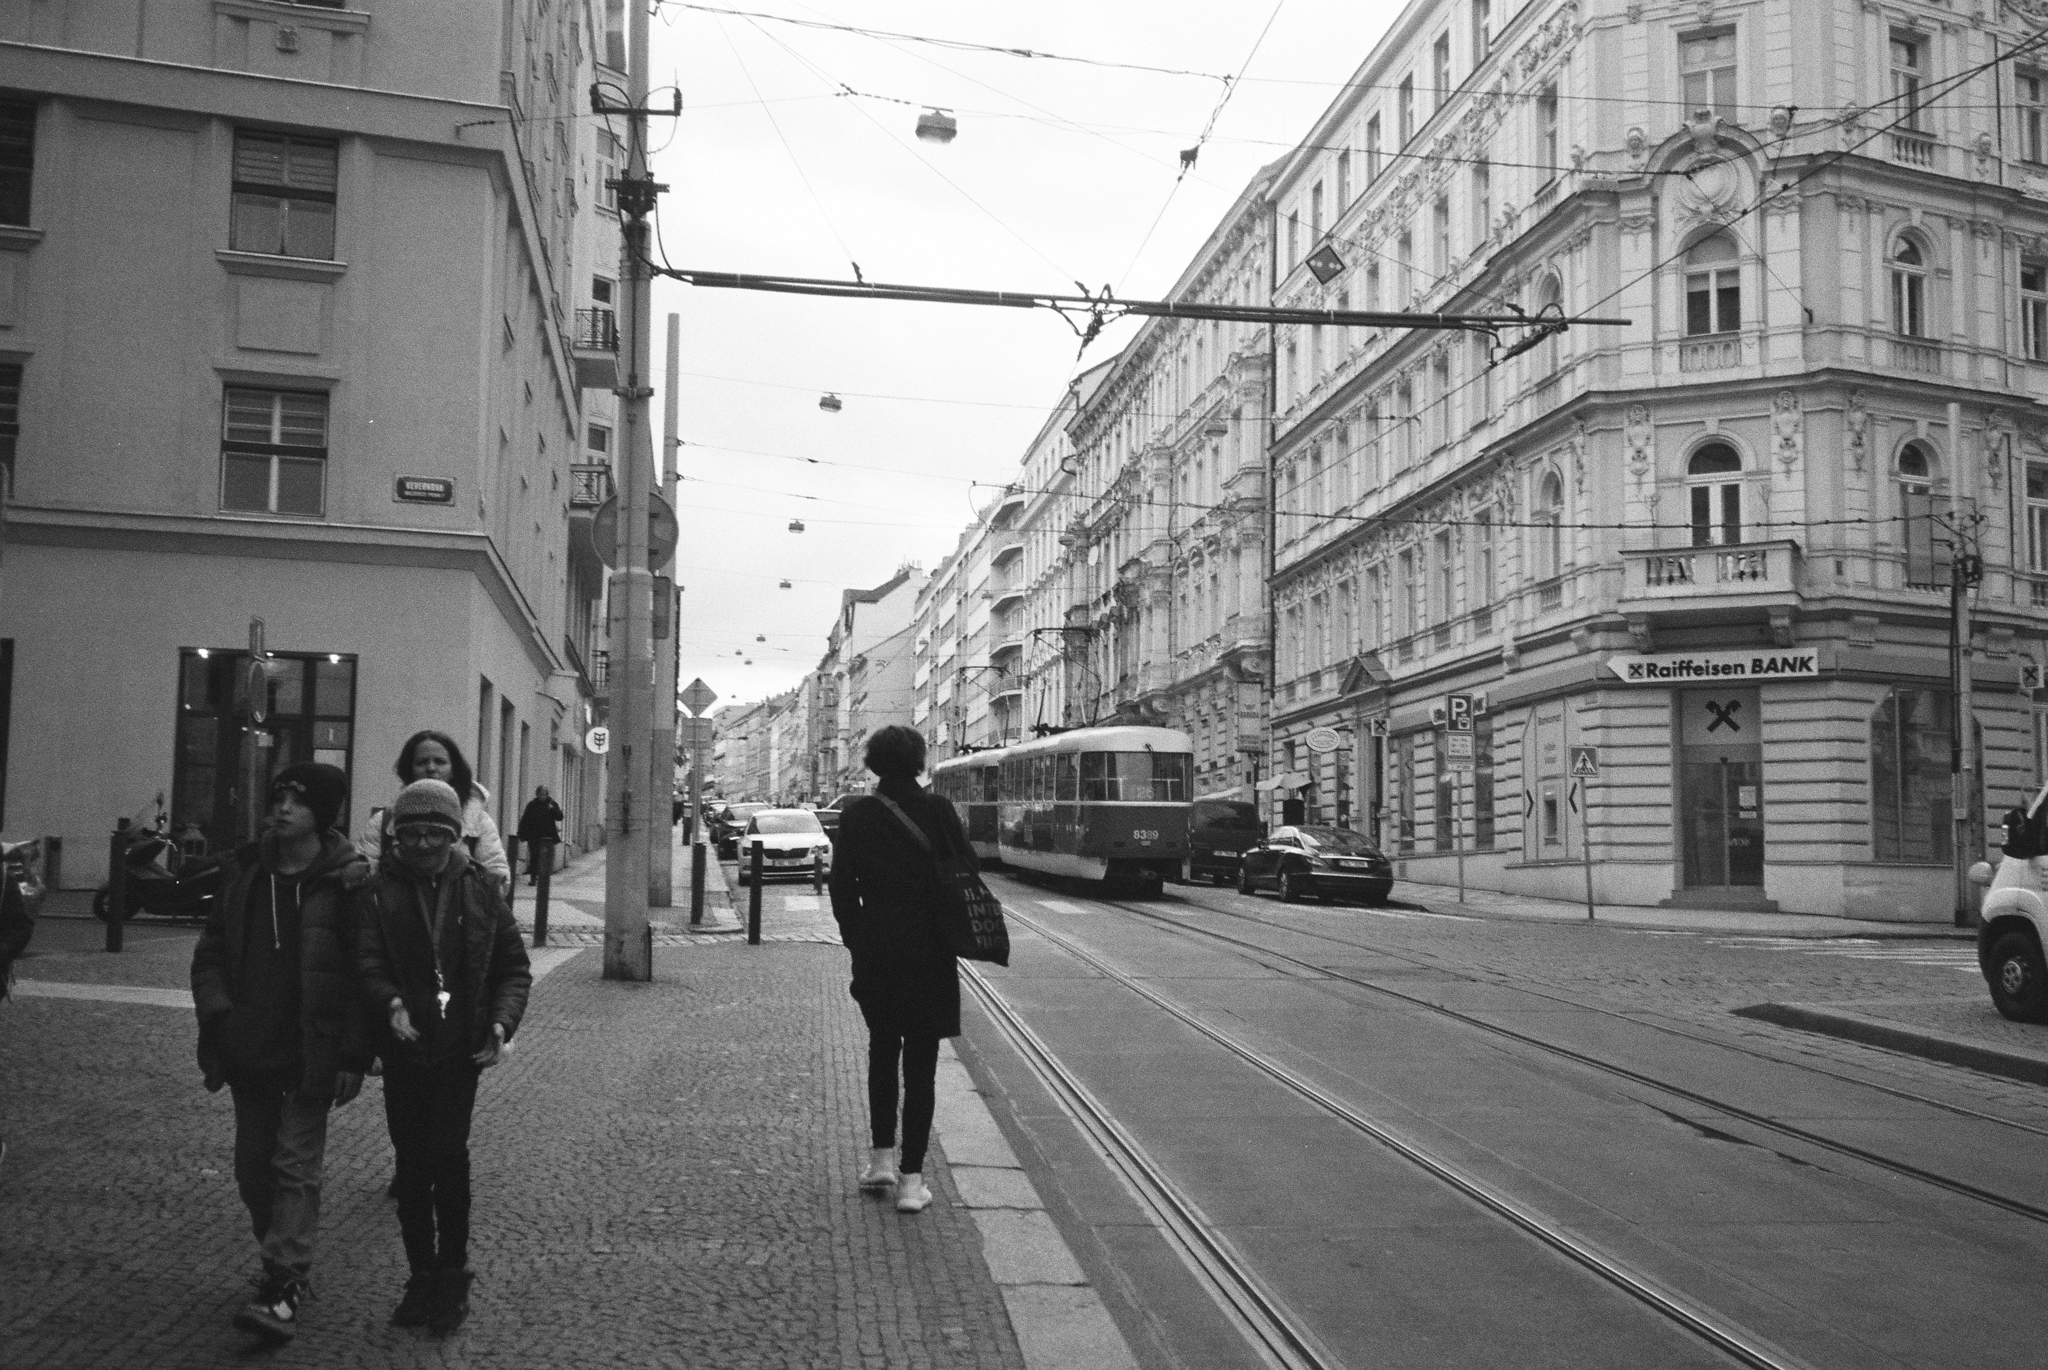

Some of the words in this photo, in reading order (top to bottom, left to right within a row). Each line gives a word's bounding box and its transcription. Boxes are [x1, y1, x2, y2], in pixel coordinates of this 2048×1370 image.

[1646, 659, 1745, 678] Raiffeisen
[1751, 656, 1814, 674] BANK
[1451, 698, 1467, 720] P
[1133, 829, 1159, 840] 8389
